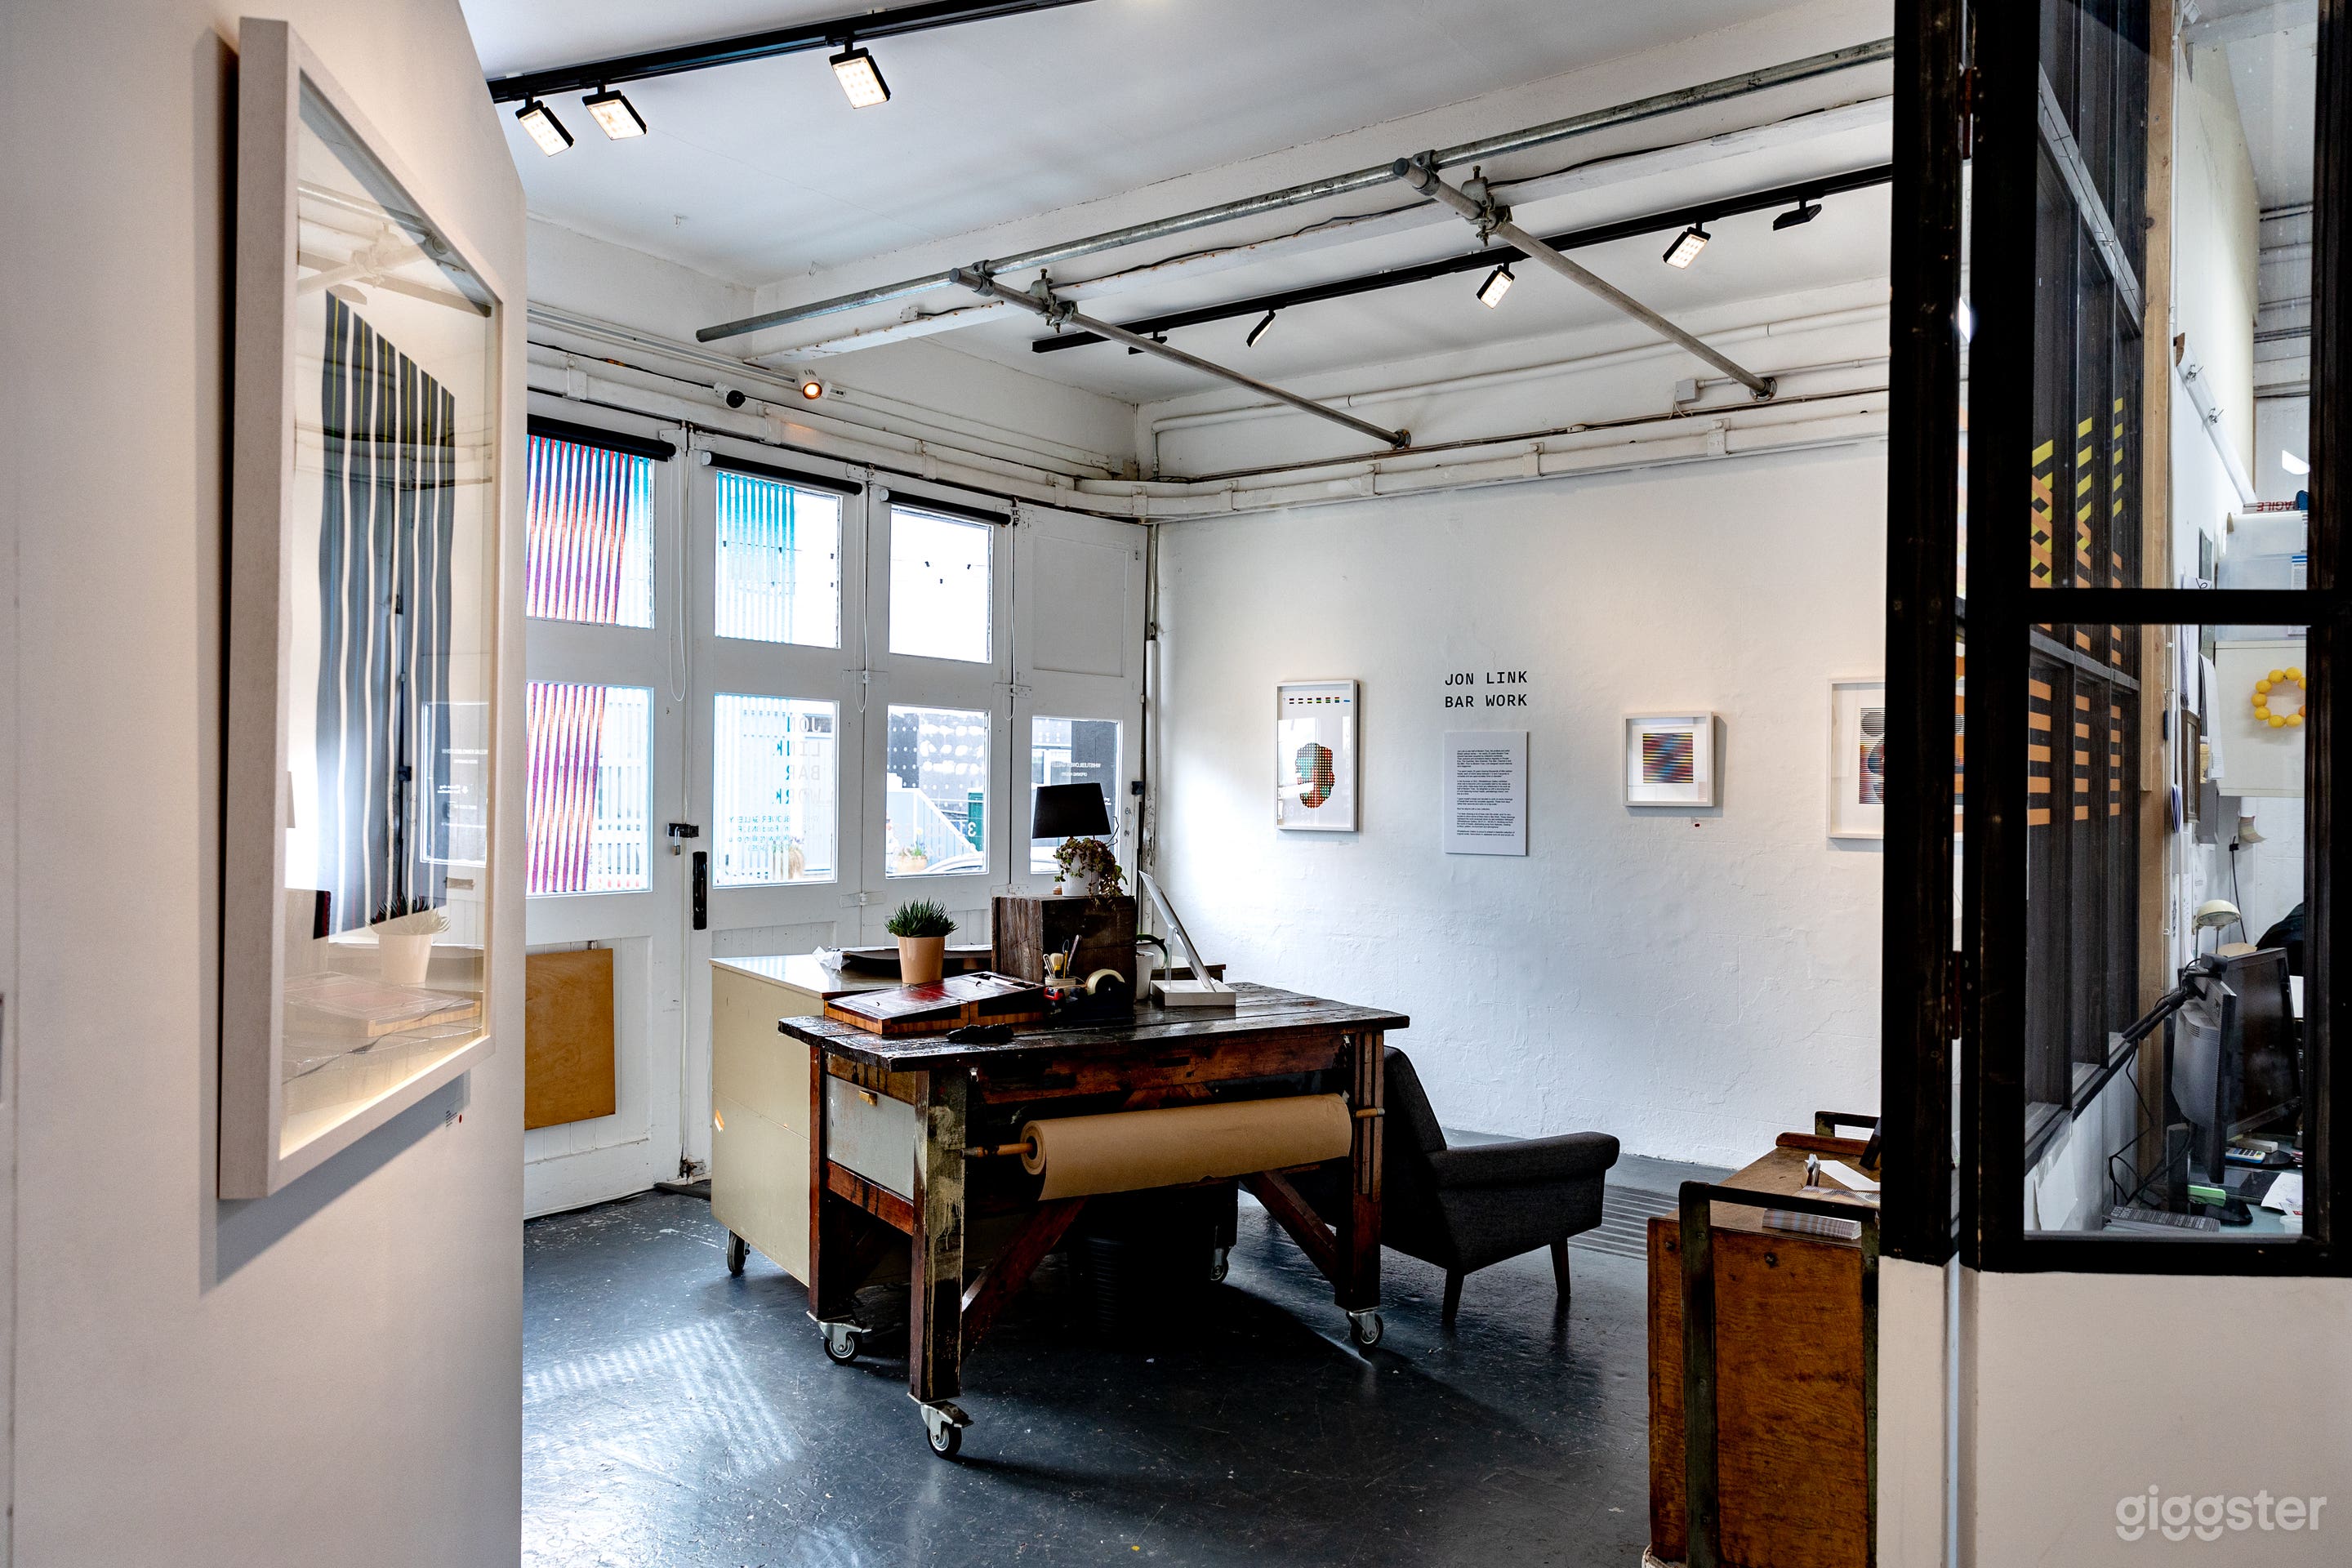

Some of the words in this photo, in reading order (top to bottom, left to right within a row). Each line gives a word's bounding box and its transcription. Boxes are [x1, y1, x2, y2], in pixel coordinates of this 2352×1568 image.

[2256, 501, 2297, 512] AGILE
[1445, 672, 1474, 686] JON
[1486, 670, 1527, 684] LINK
[1445, 695, 1474, 708] BAR
[1485, 693, 1527, 707] WORK
